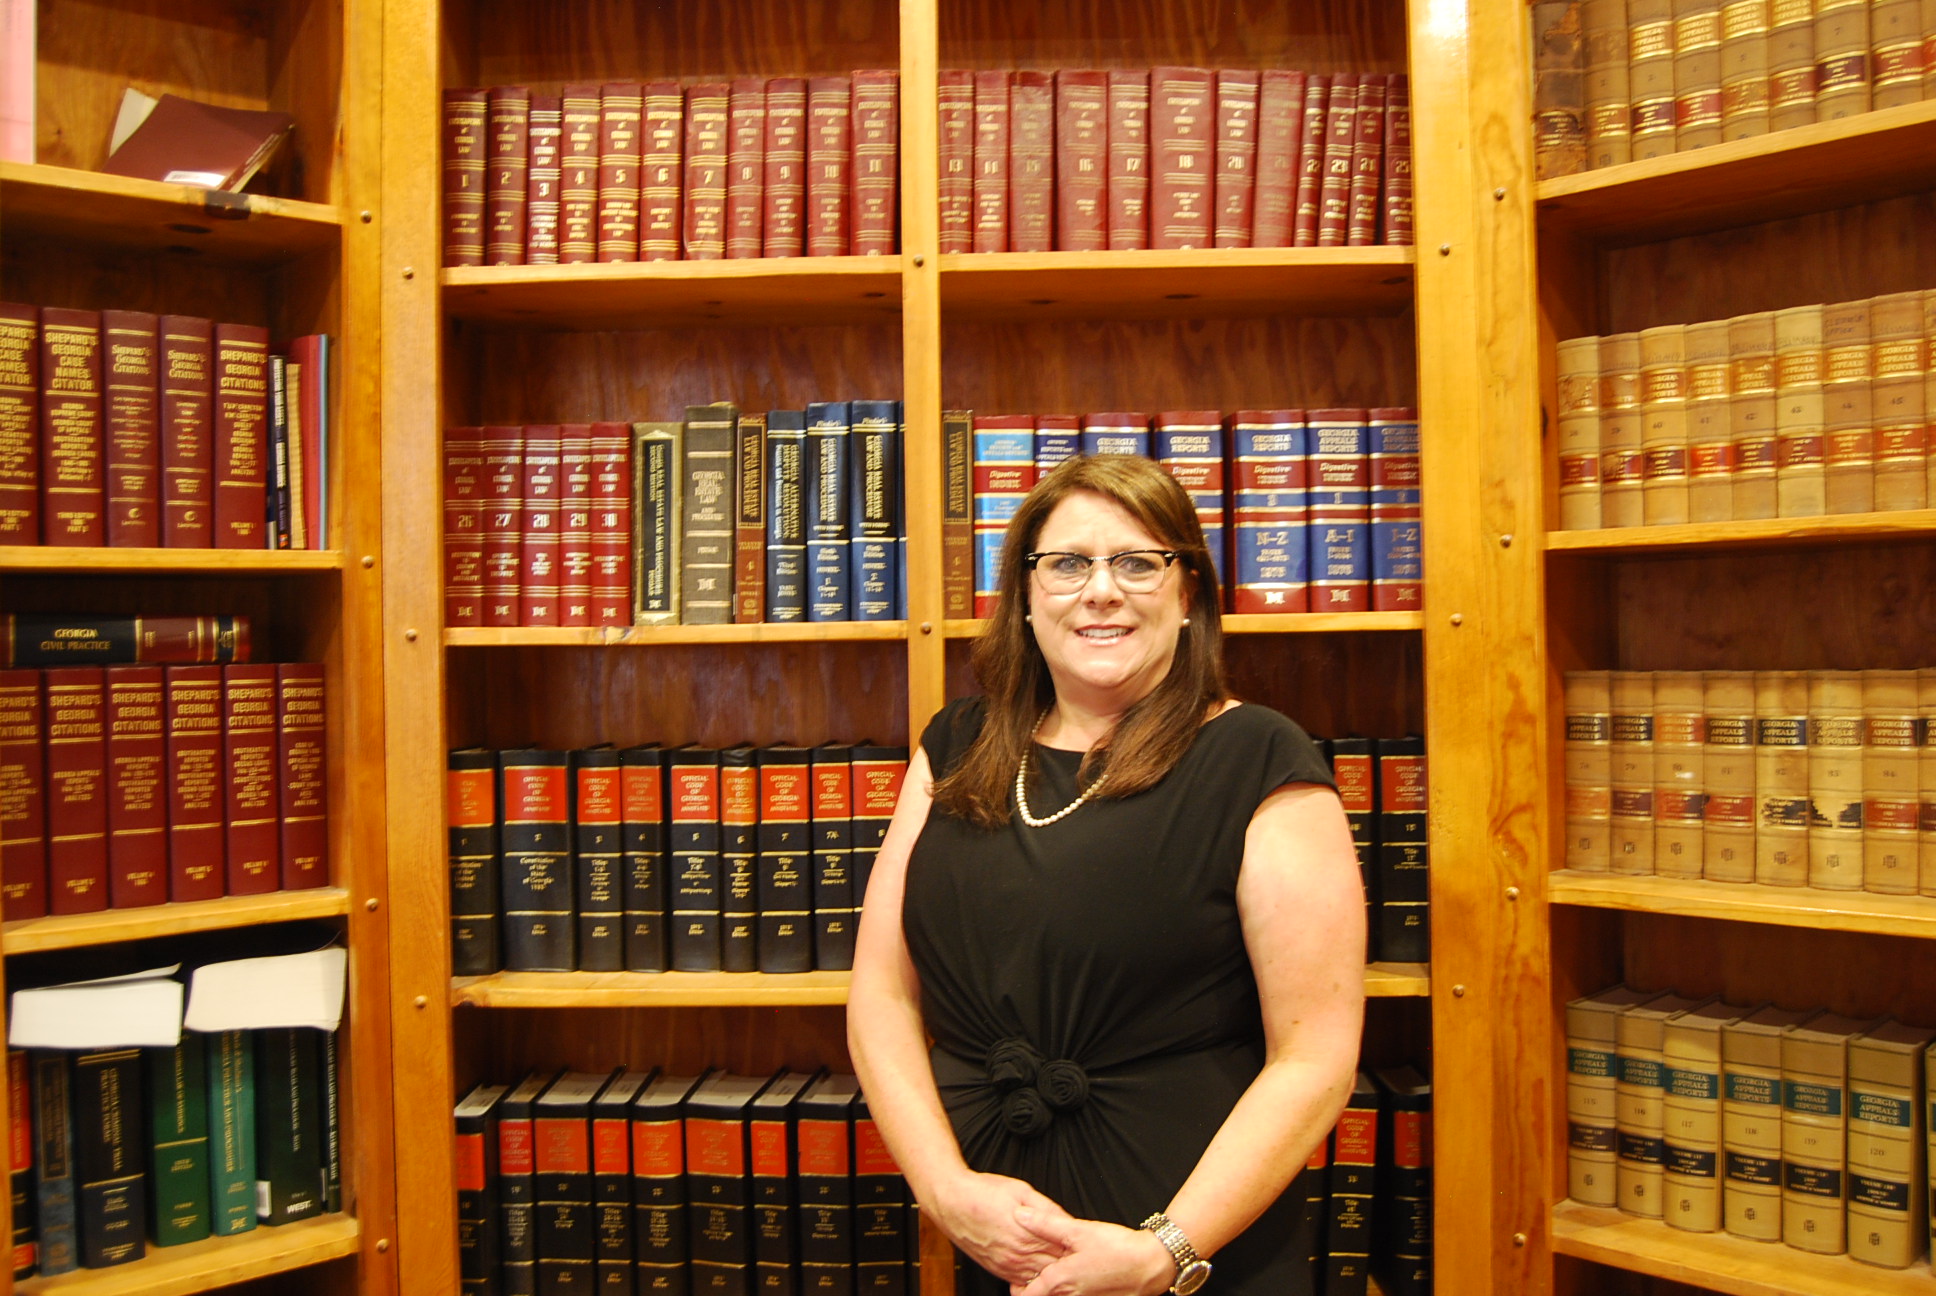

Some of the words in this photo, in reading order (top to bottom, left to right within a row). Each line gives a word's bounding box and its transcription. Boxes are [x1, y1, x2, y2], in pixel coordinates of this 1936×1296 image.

[1127, 158, 1141, 171] 17
[501, 171, 511, 184] 2
[575, 171, 586, 184] 4
[615, 169, 626, 183] 5
[658, 168, 668, 182] 6
[704, 170, 714, 184] 7
[780, 166, 790, 179] 9
[462, 174, 469, 187] 1
[539, 183, 550, 196] 3
[45, 332, 98, 346] SHEPARD'S
[51, 344, 93, 357] GEORGIA
[60, 356, 86, 367] CASE
[220, 350, 267, 364] SHEPARD'S
[55, 367, 91, 379] NAMES
[225, 363, 263, 376] GEORGIA
[52, 378, 94, 390] CITATOR
[220, 377, 267, 390] CITATIONS
[1318, 429, 1359, 437] GEORGIA
[865, 435, 874, 452] LAW
[1097, 438, 1137, 446] GEORGIA
[1170, 436, 1210, 445] GEORGIA
[1252, 435, 1292, 444] GEORGIA
[1319, 437, 1358, 445] APPEALS
[820, 438, 829, 455] LAW
[873, 435, 883, 470] GEORGIA
[1171, 445, 1209, 453] REPORTS
[1253, 443, 1291, 452] REPORTS
[1319, 444, 1358, 453] REPORTS
[827, 438, 837, 473] GEORGIA
[865, 452, 874, 470] AND
[783, 444, 791, 480] DISPUTE
[790, 444, 799, 481] GEORGIA
[820, 455, 829, 473] AND
[1320, 463, 1359, 472] Digestive
[692, 471, 725, 480] GEORGIA
[873, 471, 883, 490] REAL
[496, 485, 510, 493] LAW
[572, 484, 586, 493] LAW
[602, 484, 617, 492] LAW
[827, 474, 837, 493] REAL
[534, 485, 548, 495] LAW
[865, 471, 874, 518] PROCEDURE
[700, 496, 718, 504] LAW
[820, 474, 829, 521] PROCEDURE
[827, 494, 837, 521] ESTATE
[873, 491, 883, 519] ESTATE
[790, 484, 799, 539] ALTERNATIVE
[495, 513, 512, 527] 27
[533, 514, 550, 527] 28
[570, 513, 588, 527] 29
[601, 513, 618, 527] 30
[656, 517, 665, 534] LAW
[54, 628, 99, 639] GEORGIA
[41, 641, 64, 650] CIVIL
[67, 641, 111, 650] PRACTICE
[112, 691, 161, 704] SHEPARD'S
[171, 689, 220, 701] SHEPARD'S
[228, 687, 273, 699] SHEPARD'S
[282, 687, 324, 698] SHEPARD'S
[50, 694, 102, 707] SHEPARD'S
[287, 700, 320, 711] GEORGIA
[118, 706, 156, 717] GEORGIA
[177, 703, 216, 715] GEORGIA
[233, 701, 270, 713] GEORGIA
[56, 709, 96, 721] GEORGIA
[228, 714, 274, 726] CITATIONS
[282, 713, 324, 724] CITATIONS
[51, 722, 102, 735] CITATIONS
[113, 719, 161, 732] CITATIONS
[172, 717, 220, 729] CITATIONS
[770, 775, 799, 783] OFFICIAL
[1672, 1071, 1710, 1082] GEORGIA
[1734, 1077, 1771, 1087] GEORGIA
[1672, 1080, 1710, 1090] APPEALS
[1734, 1085, 1771, 1095] APPEALS
[1672, 1087, 1710, 1097] REPORTS
[1734, 1093, 1771, 1103] REPORTS
[1860, 1096, 1898, 1107] GEORGIA
[1860, 1104, 1898, 1116] APPEALS
[1860, 1112, 1898, 1124] REPORTS
